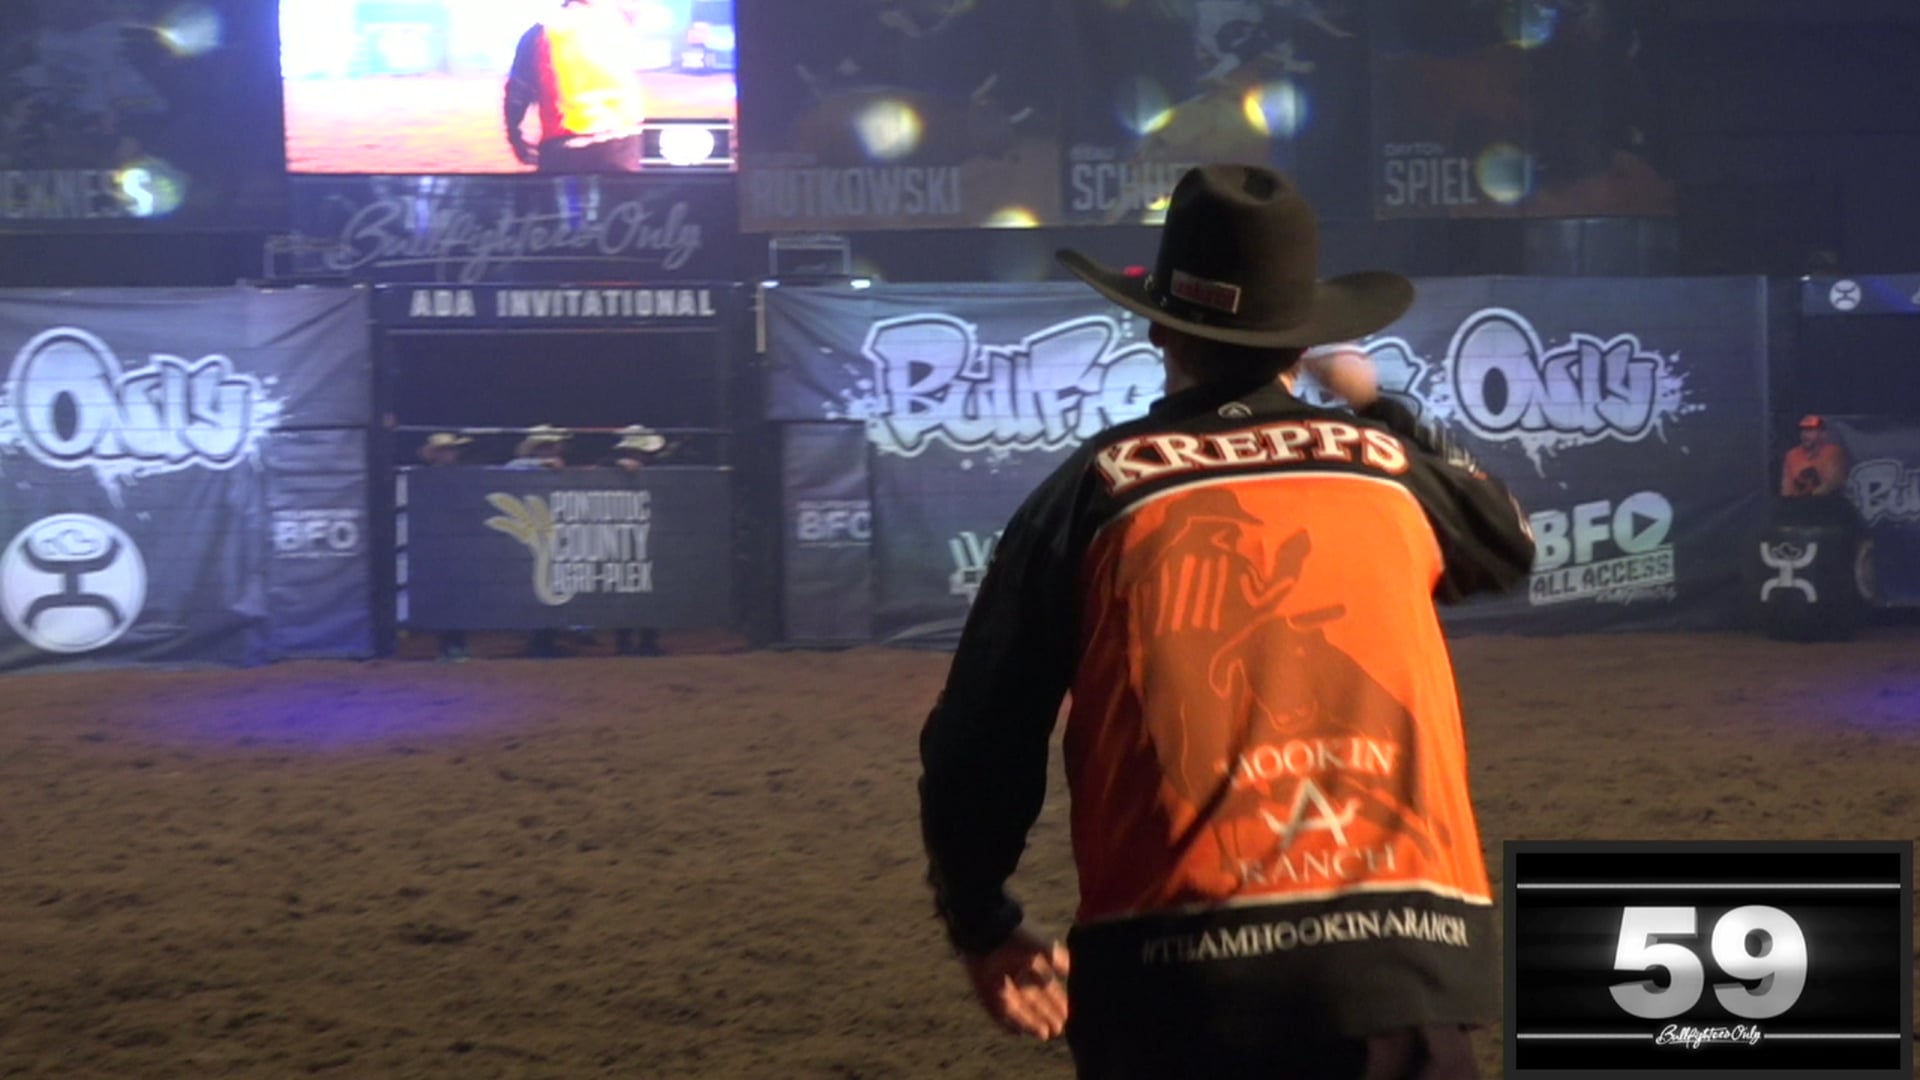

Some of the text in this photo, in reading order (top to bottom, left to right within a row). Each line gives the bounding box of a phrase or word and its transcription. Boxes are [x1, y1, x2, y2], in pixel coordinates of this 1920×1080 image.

[751, 165, 961, 216] RUTKOWSKI
[600, 200, 703, 270] Only
[410, 289, 717, 317] ADA INVITATIONAL
[1096, 419, 1408, 495] KREPPS
[273, 520, 359, 551] BFO
[552, 522, 650, 561] COUNTY
[1533, 570, 1577, 600] ALL
[1582, 553, 1670, 587] ACCESS
